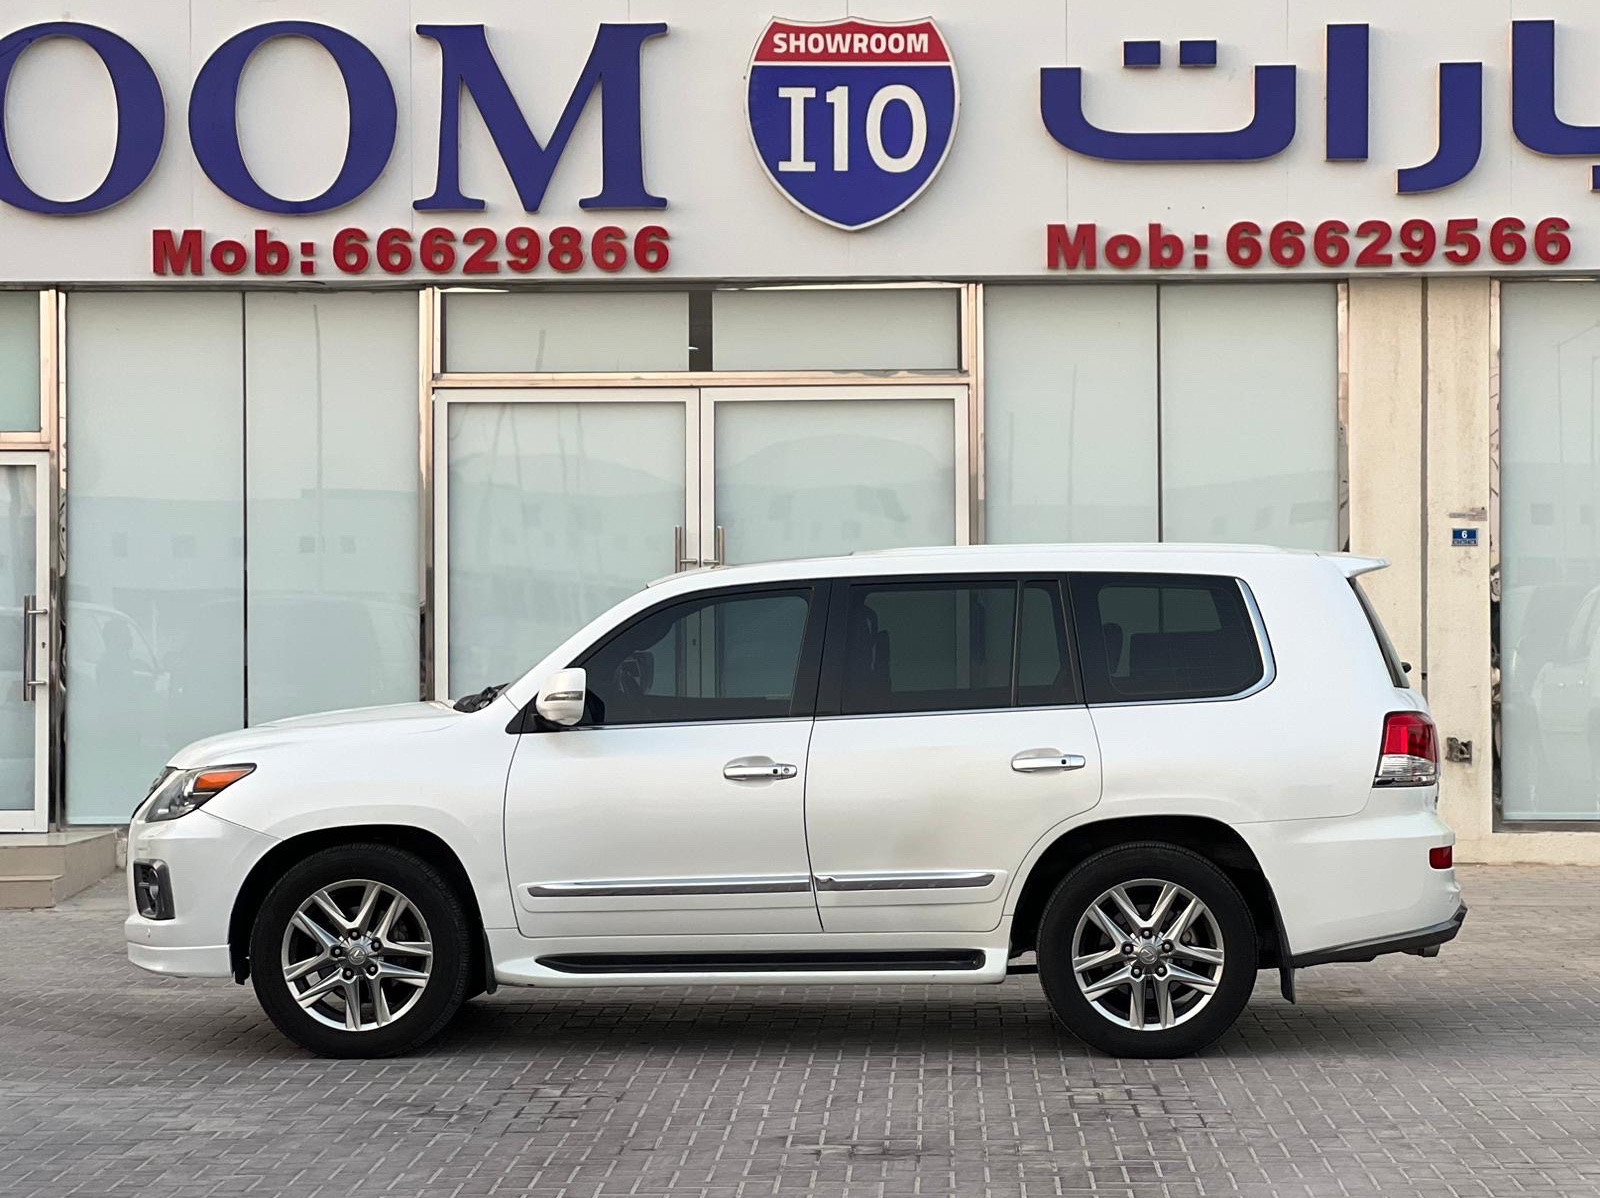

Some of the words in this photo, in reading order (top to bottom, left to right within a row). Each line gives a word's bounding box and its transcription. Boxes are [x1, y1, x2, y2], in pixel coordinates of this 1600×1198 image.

[772, 32, 930, 55] SHOWROOM
[0, 20, 668, 216] OOM
[778, 83, 928, 174] I10
[153, 229, 316, 275] Mob:
[333, 225, 671, 274] 66629866
[1046, 223, 1208, 269] Mob:
[1226, 217, 1572, 267] 66629566
[1461, 530, 1468, 539] 6
